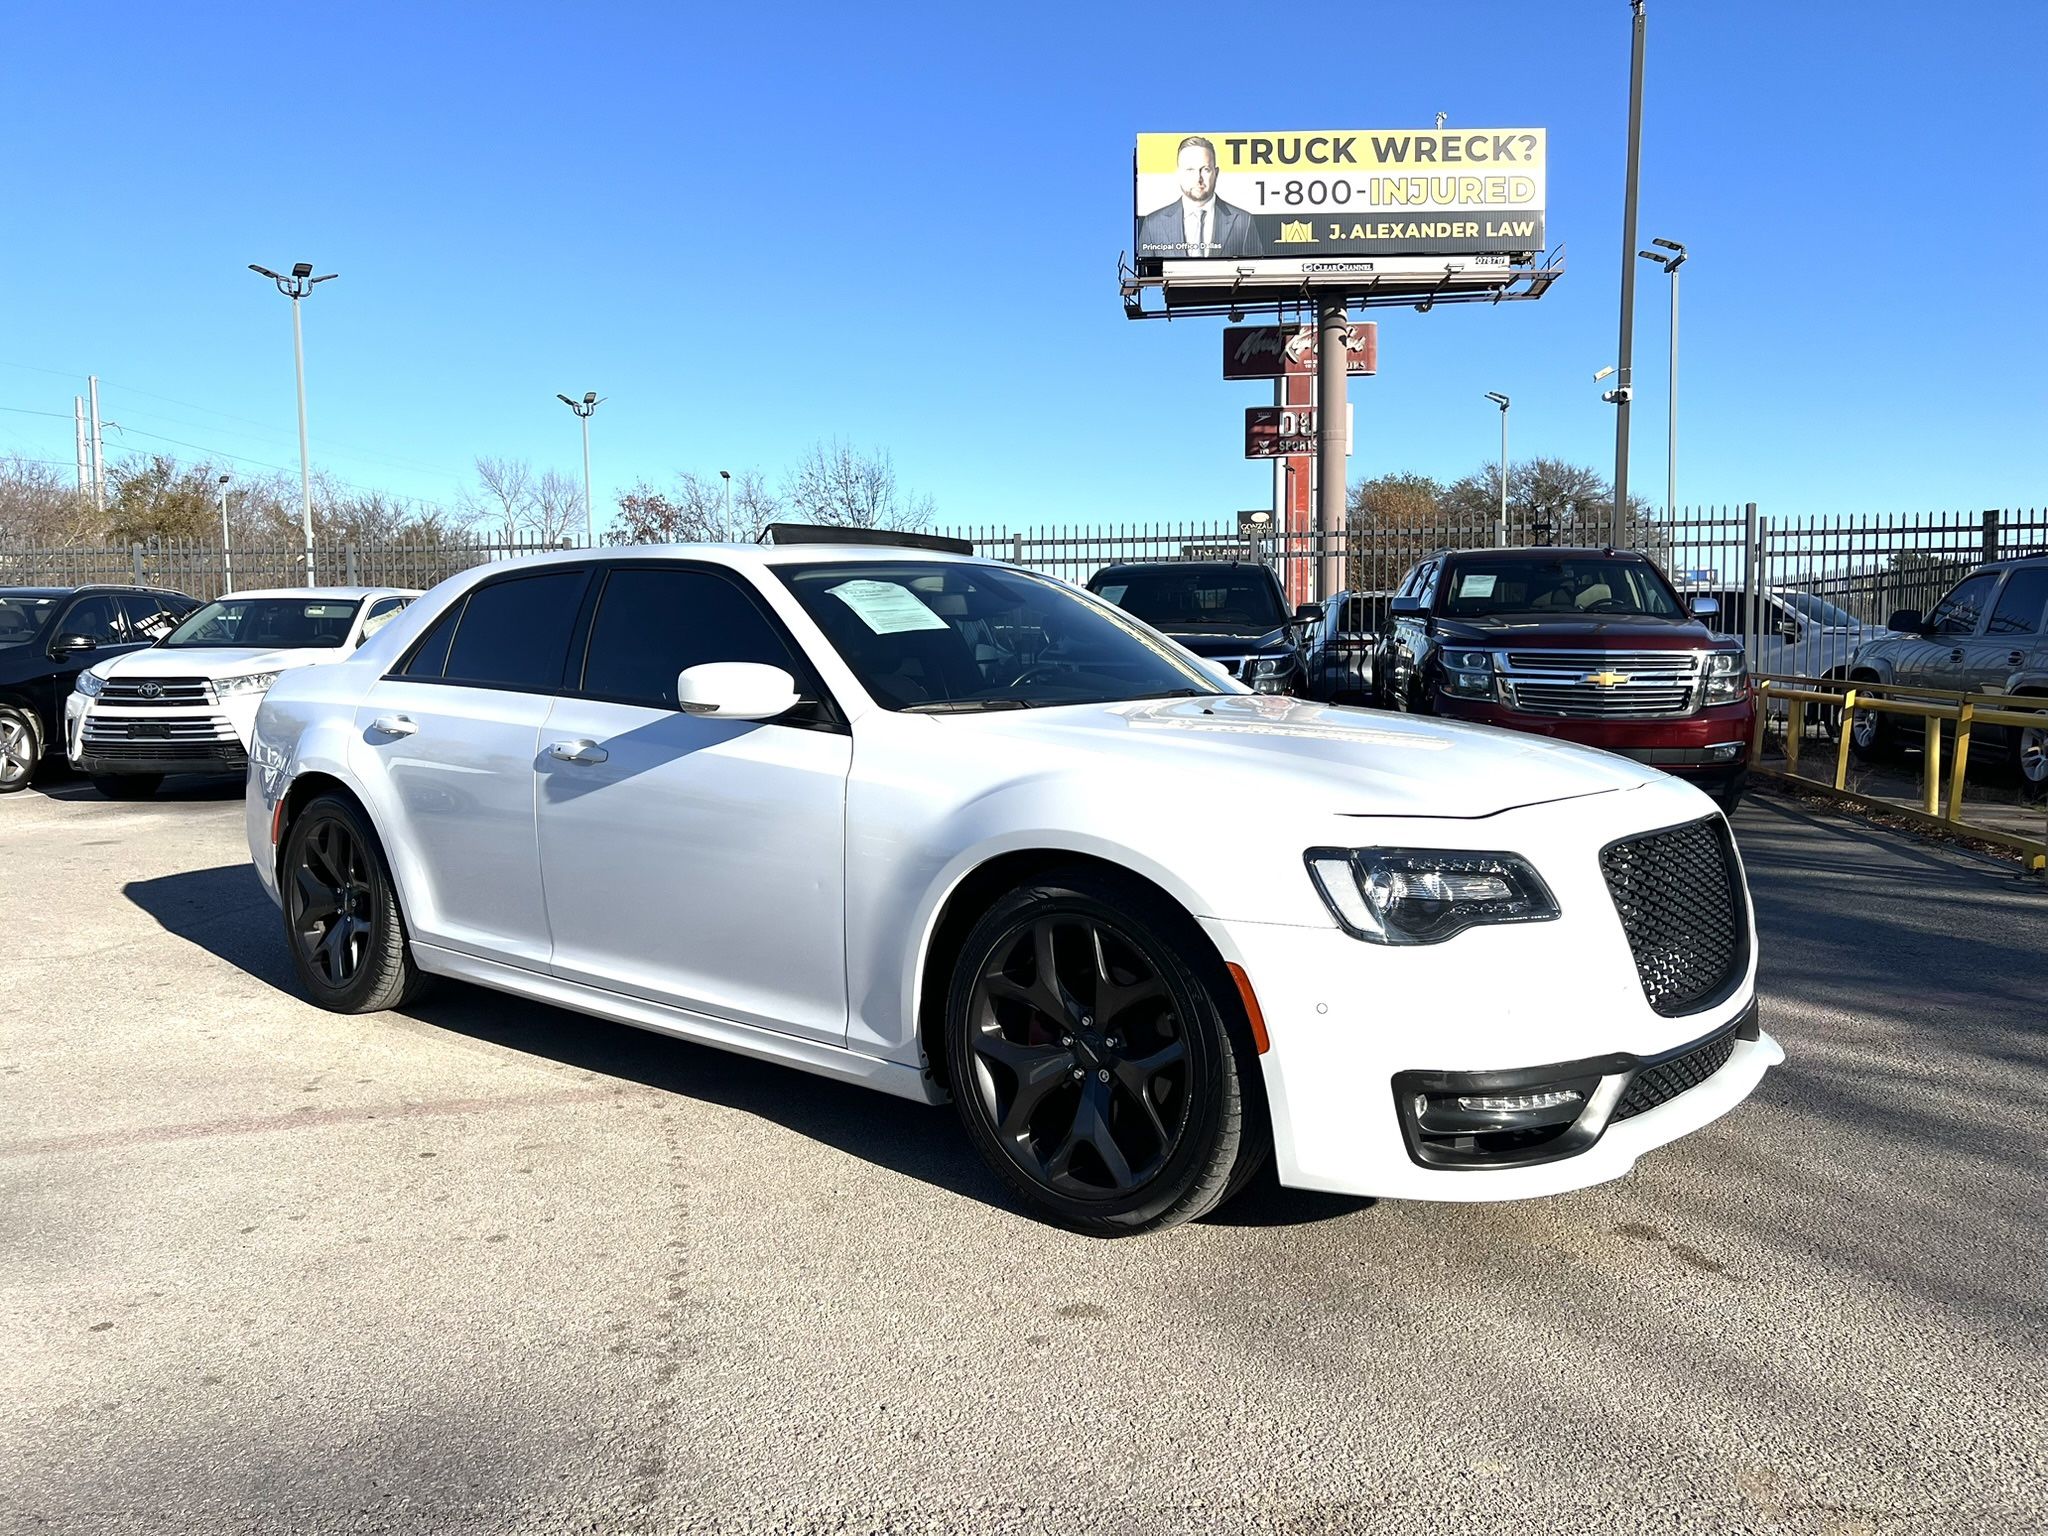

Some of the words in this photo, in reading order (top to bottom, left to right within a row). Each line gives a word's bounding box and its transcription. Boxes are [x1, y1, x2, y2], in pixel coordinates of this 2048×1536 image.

[1225, 136, 1357, 165] TRUCK
[1371, 134, 1537, 163] WRECK?
[1485, 221, 1535, 238] LAW
[1142, 243, 1174, 251] Principal
